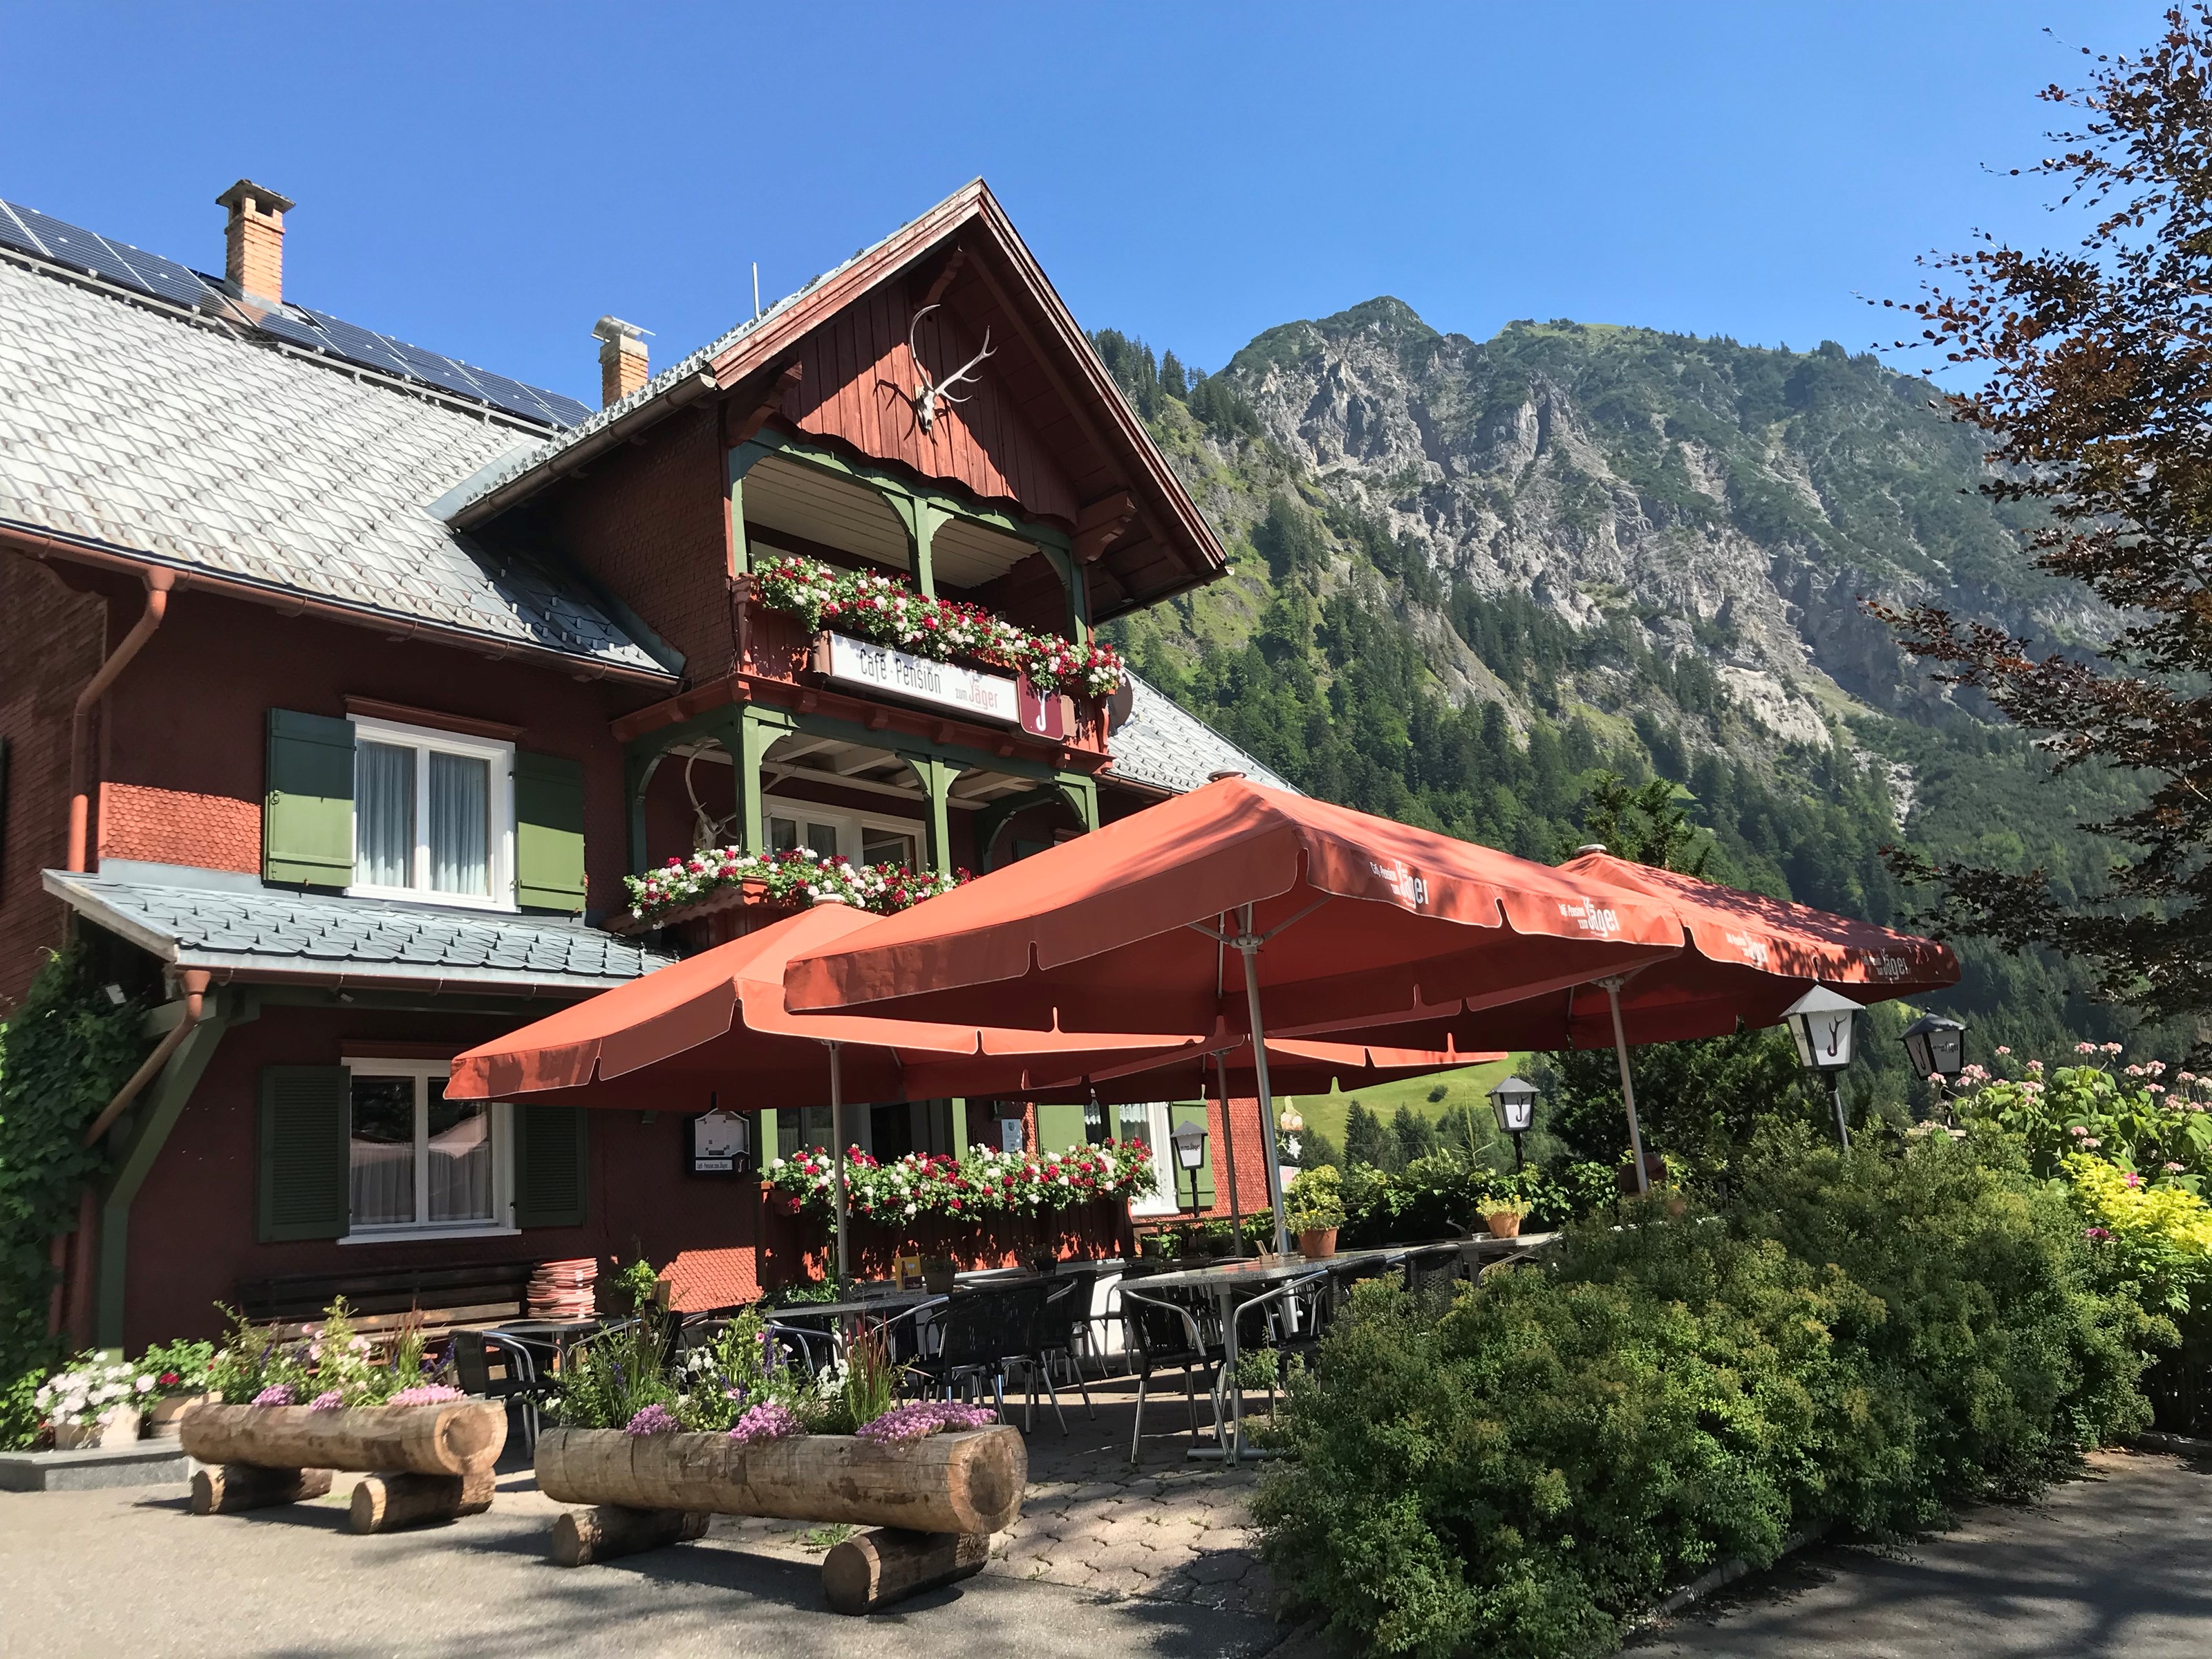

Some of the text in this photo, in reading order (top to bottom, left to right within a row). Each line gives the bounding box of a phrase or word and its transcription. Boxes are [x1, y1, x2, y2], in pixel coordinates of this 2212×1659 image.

[860, 648, 998, 711] Café Pension zum Jäger
